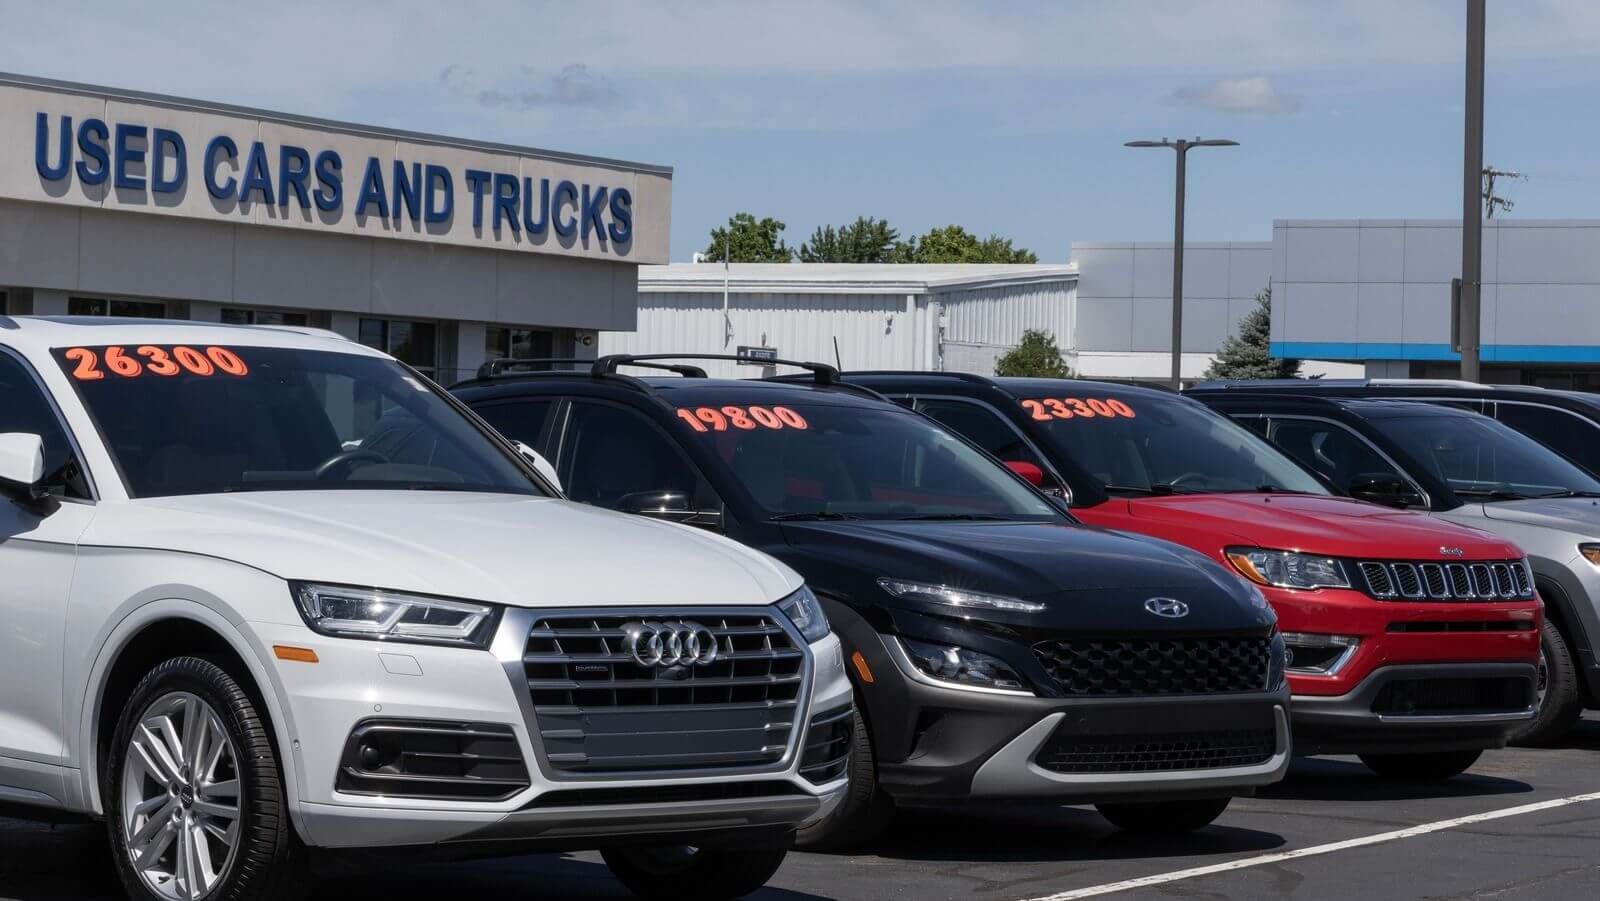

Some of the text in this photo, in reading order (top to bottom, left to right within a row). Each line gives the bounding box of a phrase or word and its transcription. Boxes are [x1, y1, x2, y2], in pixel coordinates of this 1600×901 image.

[36, 112, 633, 243] USED CARS AND TRUCKS
[65, 346, 248, 380] 26300
[676, 405, 808, 433] 19800
[1021, 398, 1136, 421] 23300
